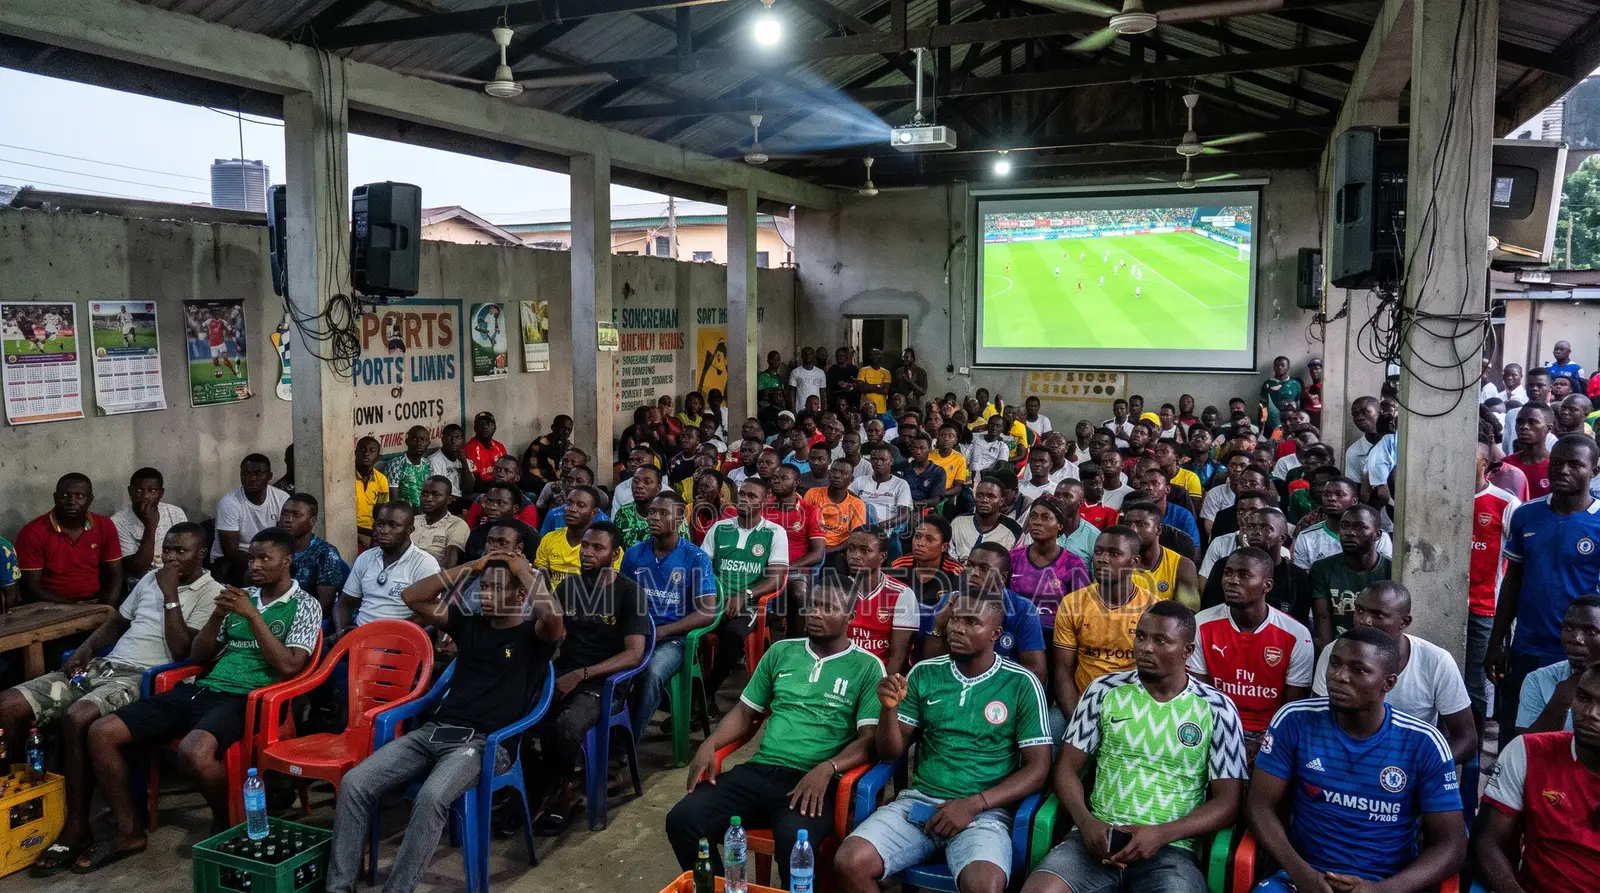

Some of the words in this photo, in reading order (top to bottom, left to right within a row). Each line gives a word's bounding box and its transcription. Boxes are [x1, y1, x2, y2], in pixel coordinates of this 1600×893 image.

[395, 399, 444, 421] COORTS
[853, 627, 870, 639] Fly
[850, 636, 890, 650] irates
[1236, 668, 1255, 683] Fly
[1213, 676, 1278, 699] Emirates
[1323, 789, 1401, 814] YAMSUNG
